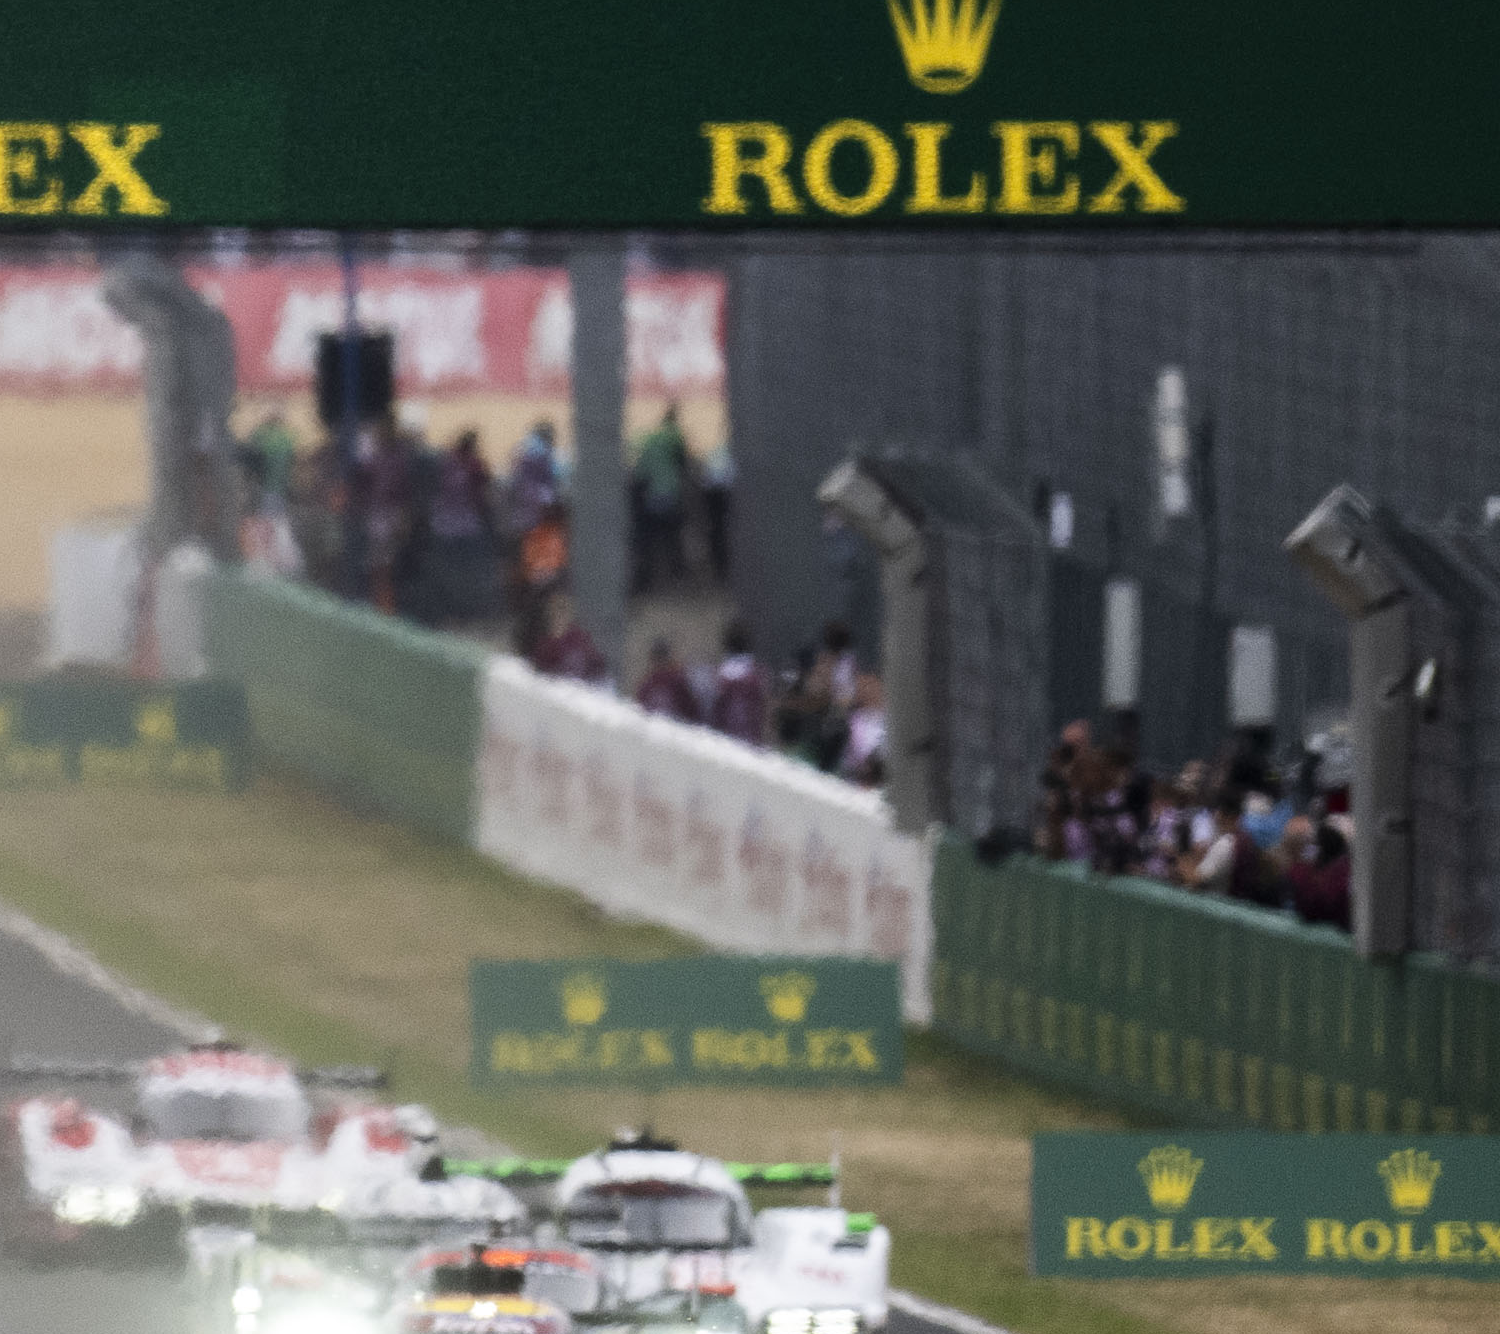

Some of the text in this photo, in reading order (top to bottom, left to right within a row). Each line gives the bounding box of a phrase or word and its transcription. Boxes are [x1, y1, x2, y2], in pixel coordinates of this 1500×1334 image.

[701, 118, 1186, 218] ROLEX
[691, 1029, 878, 1071] ROLEX
[1064, 1216, 1500, 1264] ROLEX ROLEX
